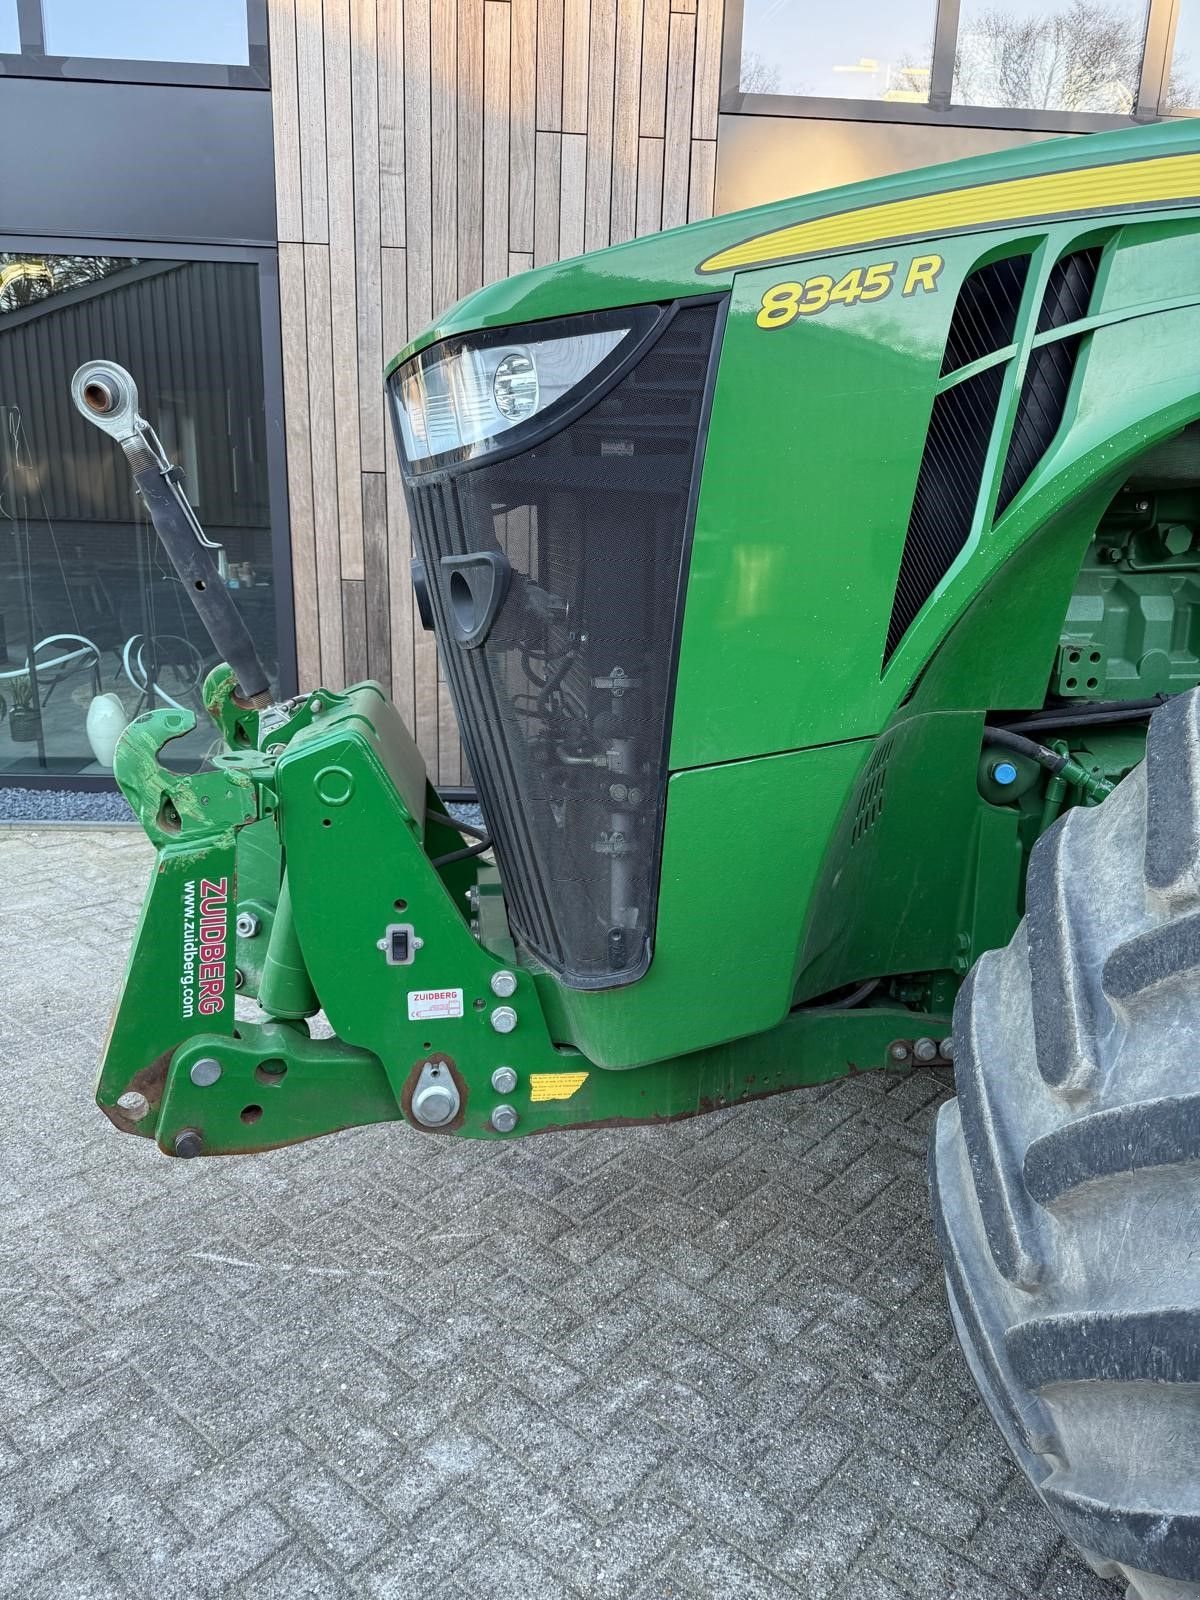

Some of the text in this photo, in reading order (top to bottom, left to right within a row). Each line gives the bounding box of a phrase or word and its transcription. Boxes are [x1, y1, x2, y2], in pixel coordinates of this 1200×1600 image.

[756, 254, 945, 331] 8345 R
[181, 880, 199, 1018] www.zuidberg.com
[198, 877, 227, 1016] ZUIDBERG
[413, 991, 458, 1001] ZUIDBERG
